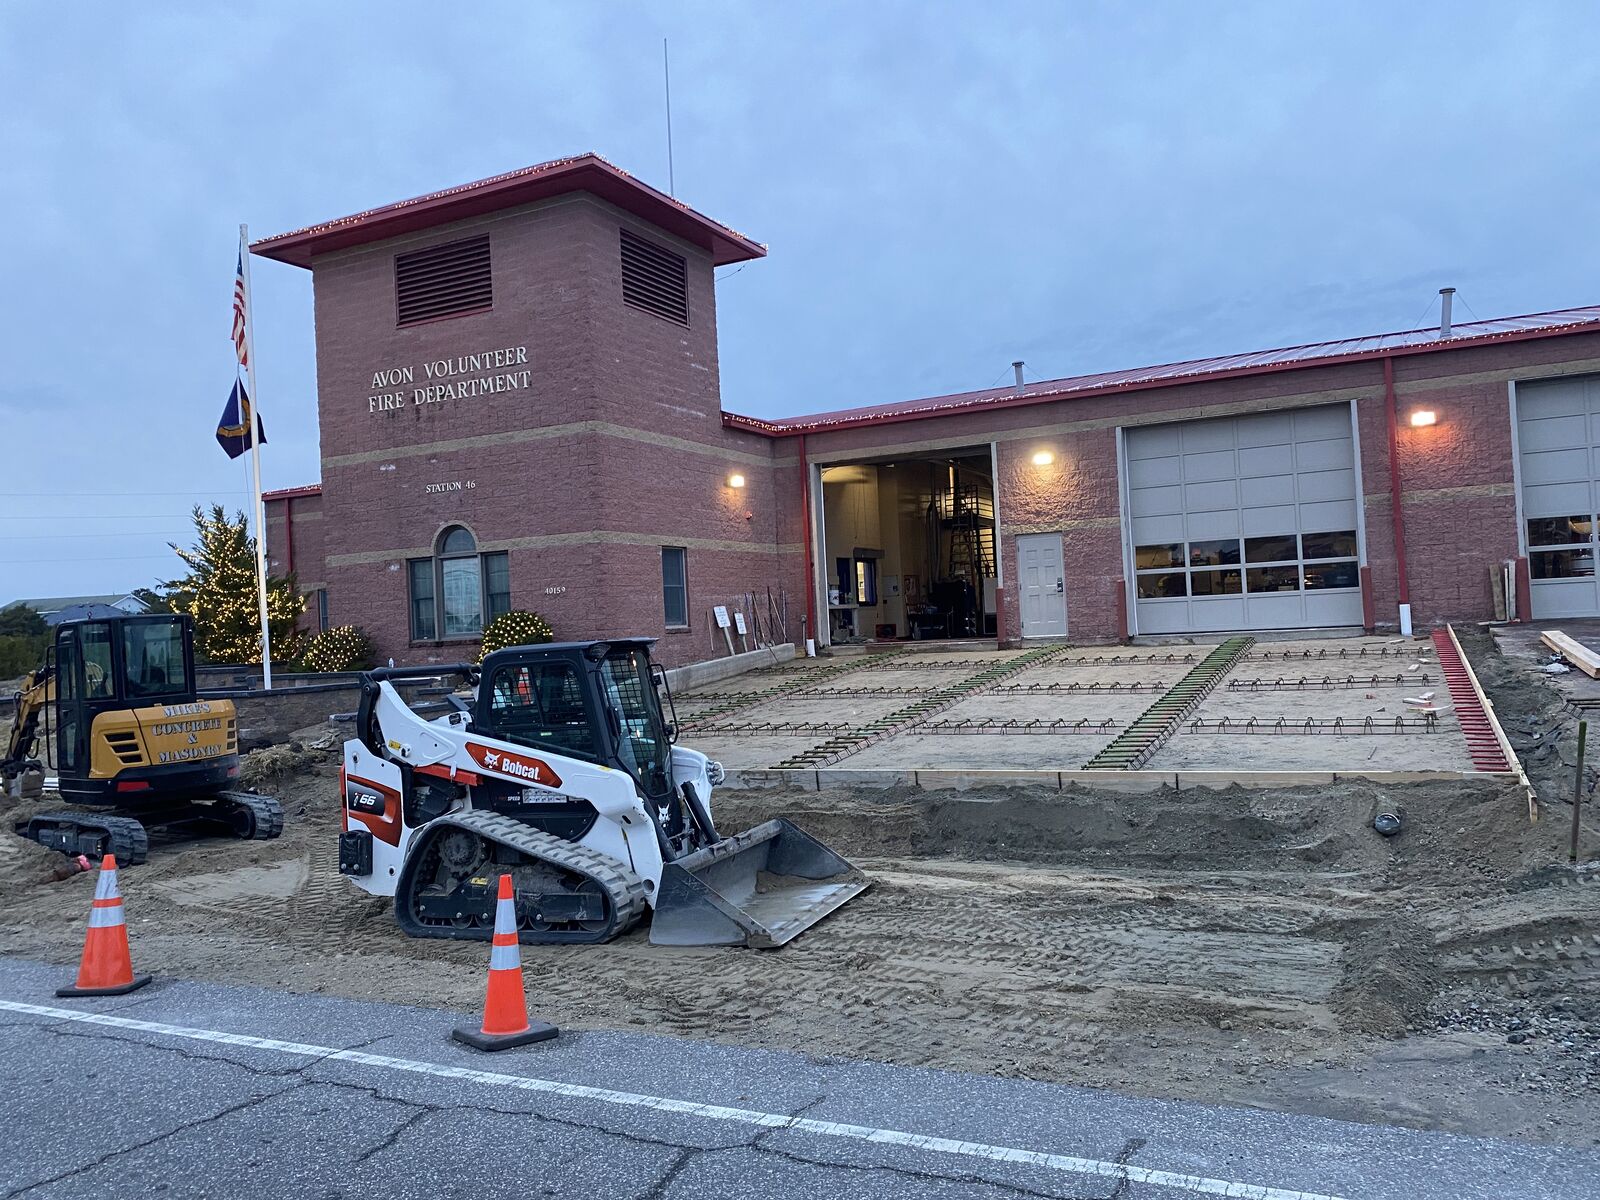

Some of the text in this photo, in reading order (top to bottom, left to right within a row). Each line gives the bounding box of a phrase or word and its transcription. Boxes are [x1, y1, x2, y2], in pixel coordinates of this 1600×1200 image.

[371, 346, 528, 389] AVON VOLUNTEER
[368, 370, 532, 413] FIRE DEPARTMENT
[425, 480, 476, 494] STATION 46
[544, 586, 566, 595] 40159
[164, 703, 211, 718] MIKE'S
[152, 718, 222, 737] CONCRETE
[187, 732, 198, 744] &
[159, 744, 222, 763] MASONRY
[501, 758, 540, 781] Bobcat
